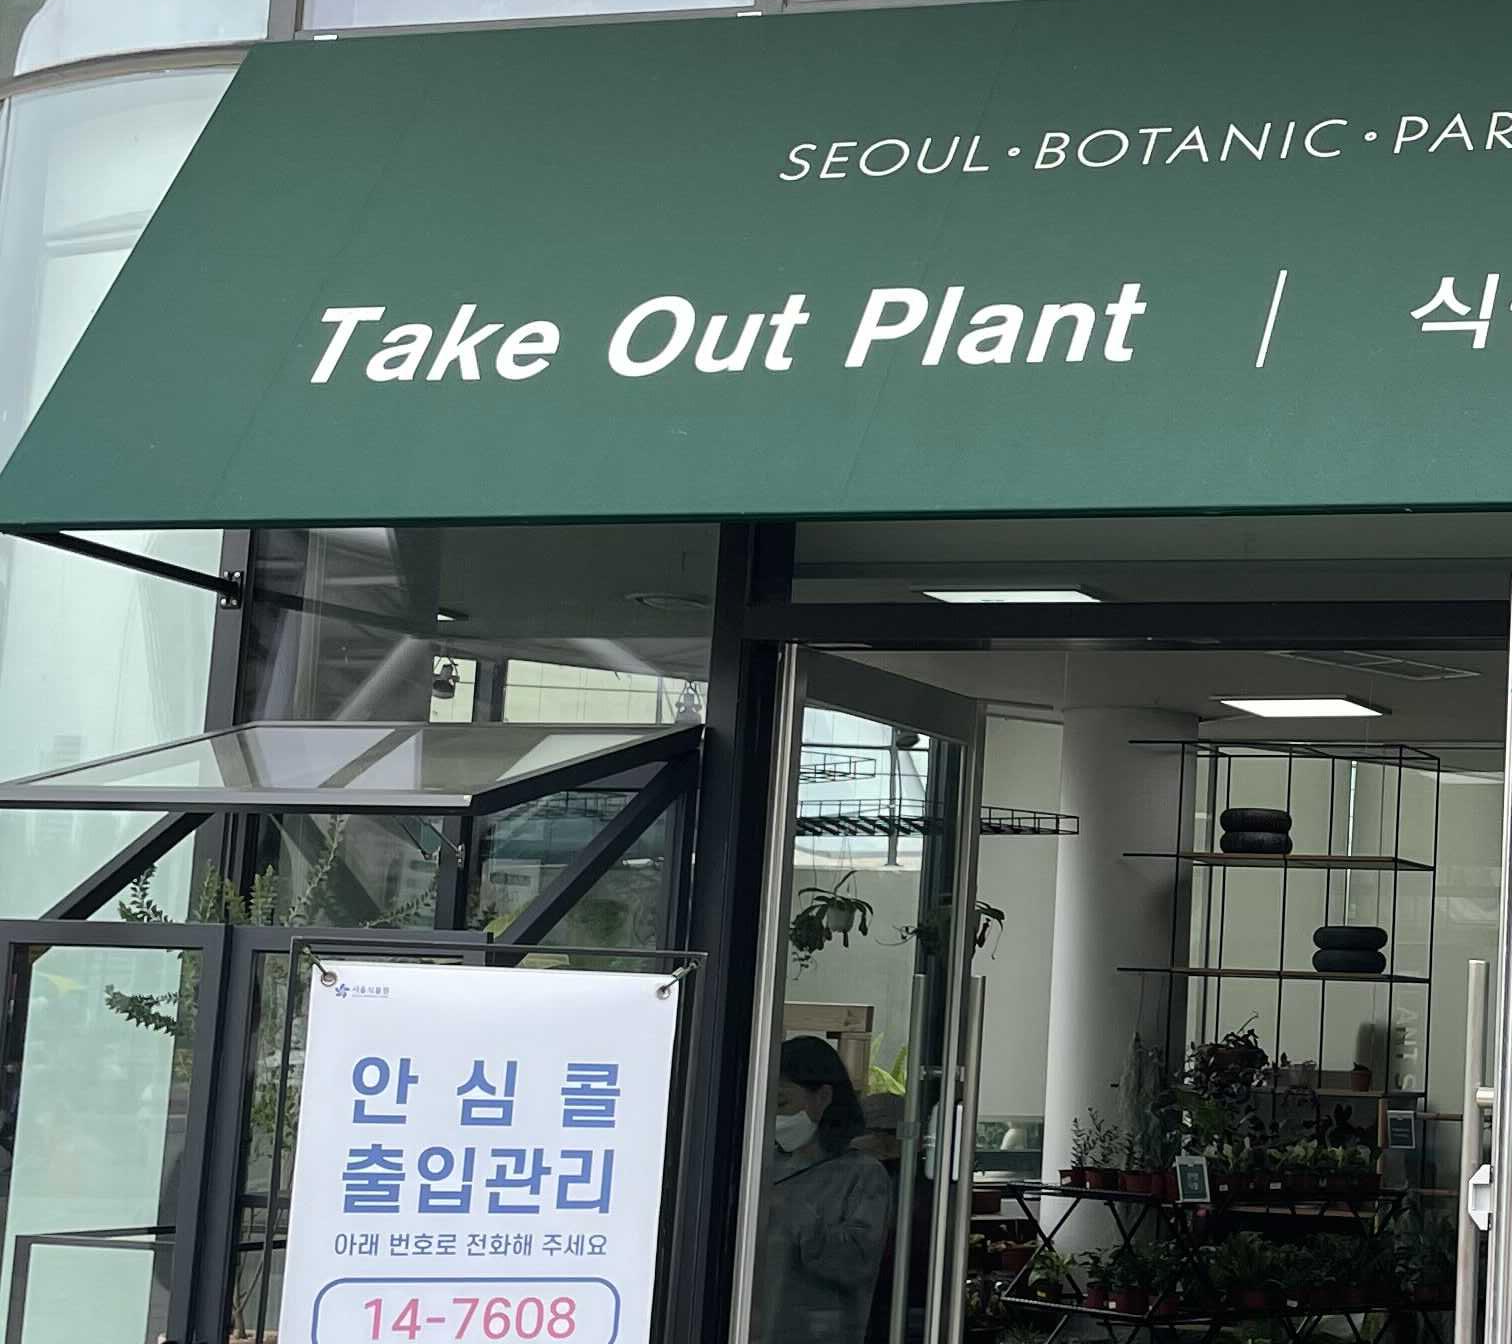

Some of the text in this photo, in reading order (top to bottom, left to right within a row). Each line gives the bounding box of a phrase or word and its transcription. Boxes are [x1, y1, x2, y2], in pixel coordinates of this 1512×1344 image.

[780, 135, 988, 182] SEOUL
[1035, 117, 1349, 169] BOTANIC
[310, 303, 561, 384] Take
[607, 292, 809, 378] Out
[844, 283, 1146, 369] Plant
[342, 1143, 615, 1214] 출입관리
[335, 1233, 607, 1256] 아래 번호로 전화해 주세요
[364, 1296, 576, 1340] 14-7608
